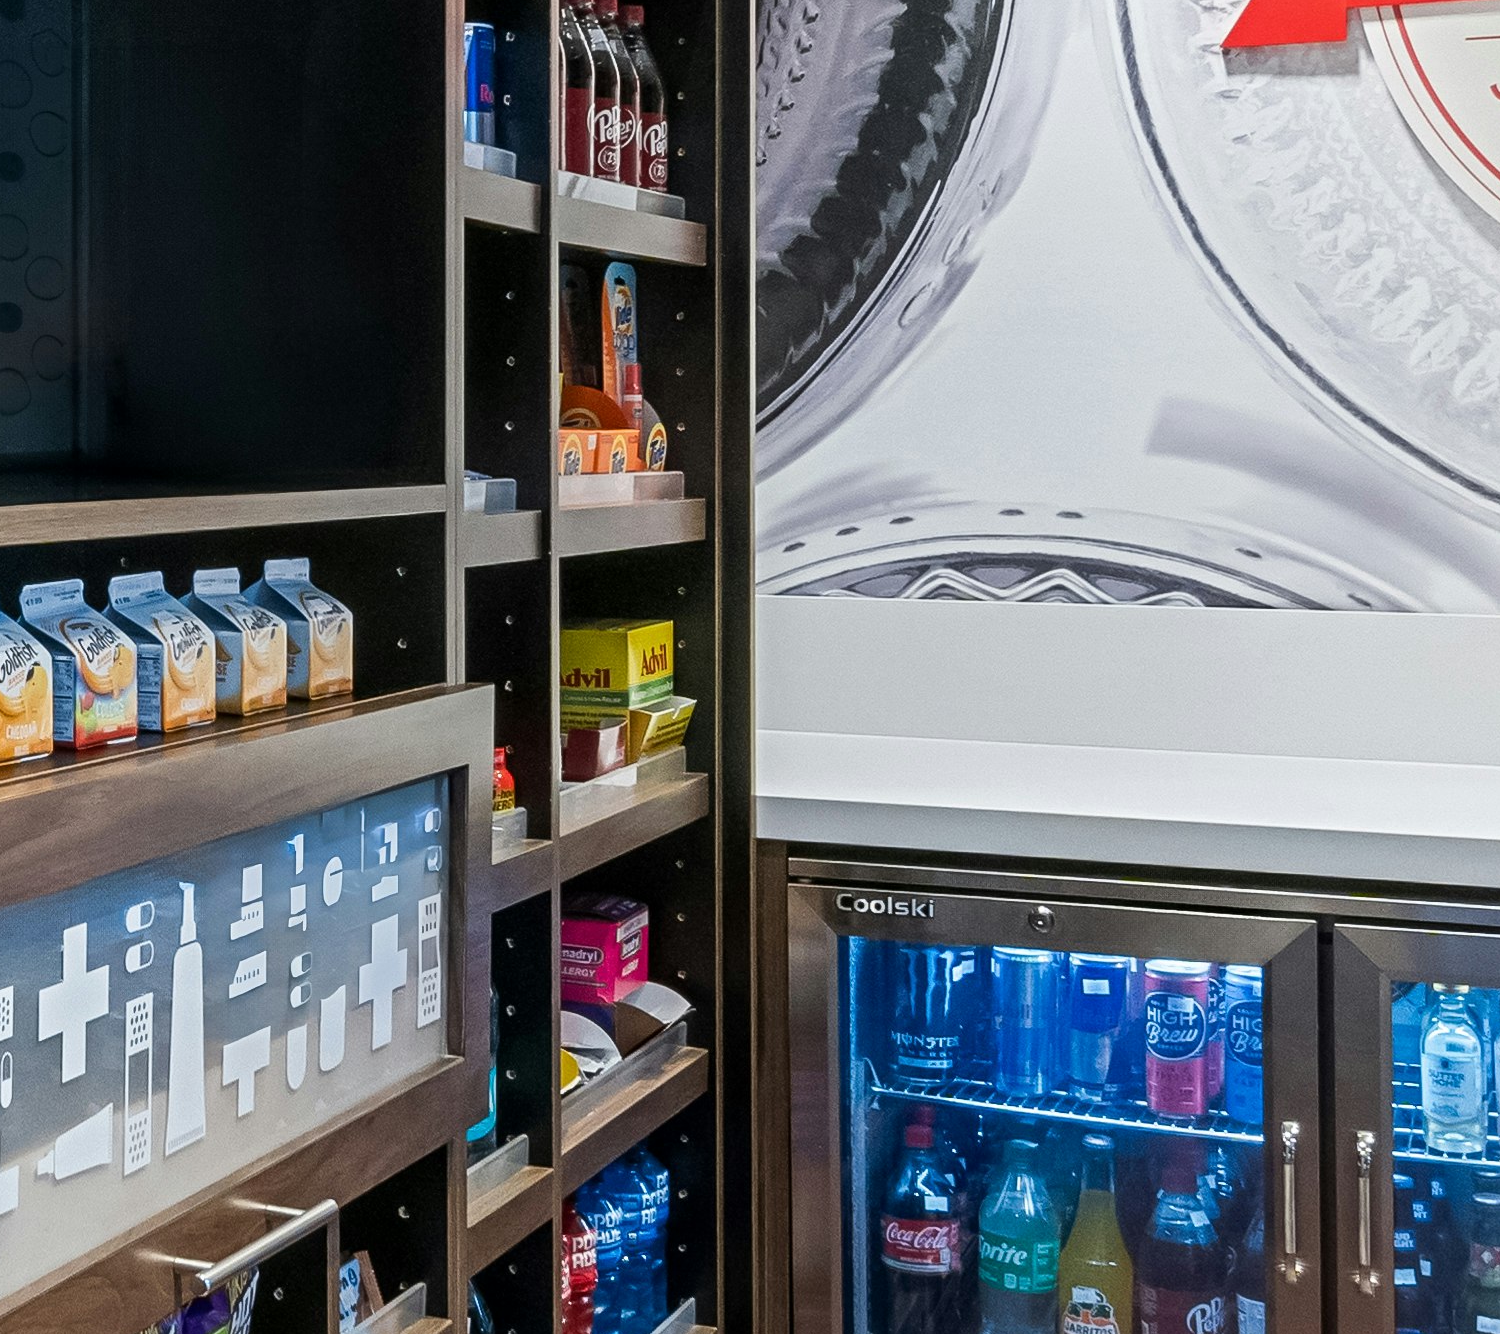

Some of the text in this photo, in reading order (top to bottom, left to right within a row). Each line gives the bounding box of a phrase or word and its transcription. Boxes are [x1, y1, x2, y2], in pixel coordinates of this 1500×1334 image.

[78, 624, 121, 664] Goldfish
[641, 643, 668, 676] Advil
[6, 720, 37, 740] CHEDDAR
[835, 892, 936, 919] Coolski
[1147, 1008, 1197, 1026] HIGH
[1147, 1021, 1199, 1044] Brew
[886, 1222, 950, 1249] Coca-Cola
